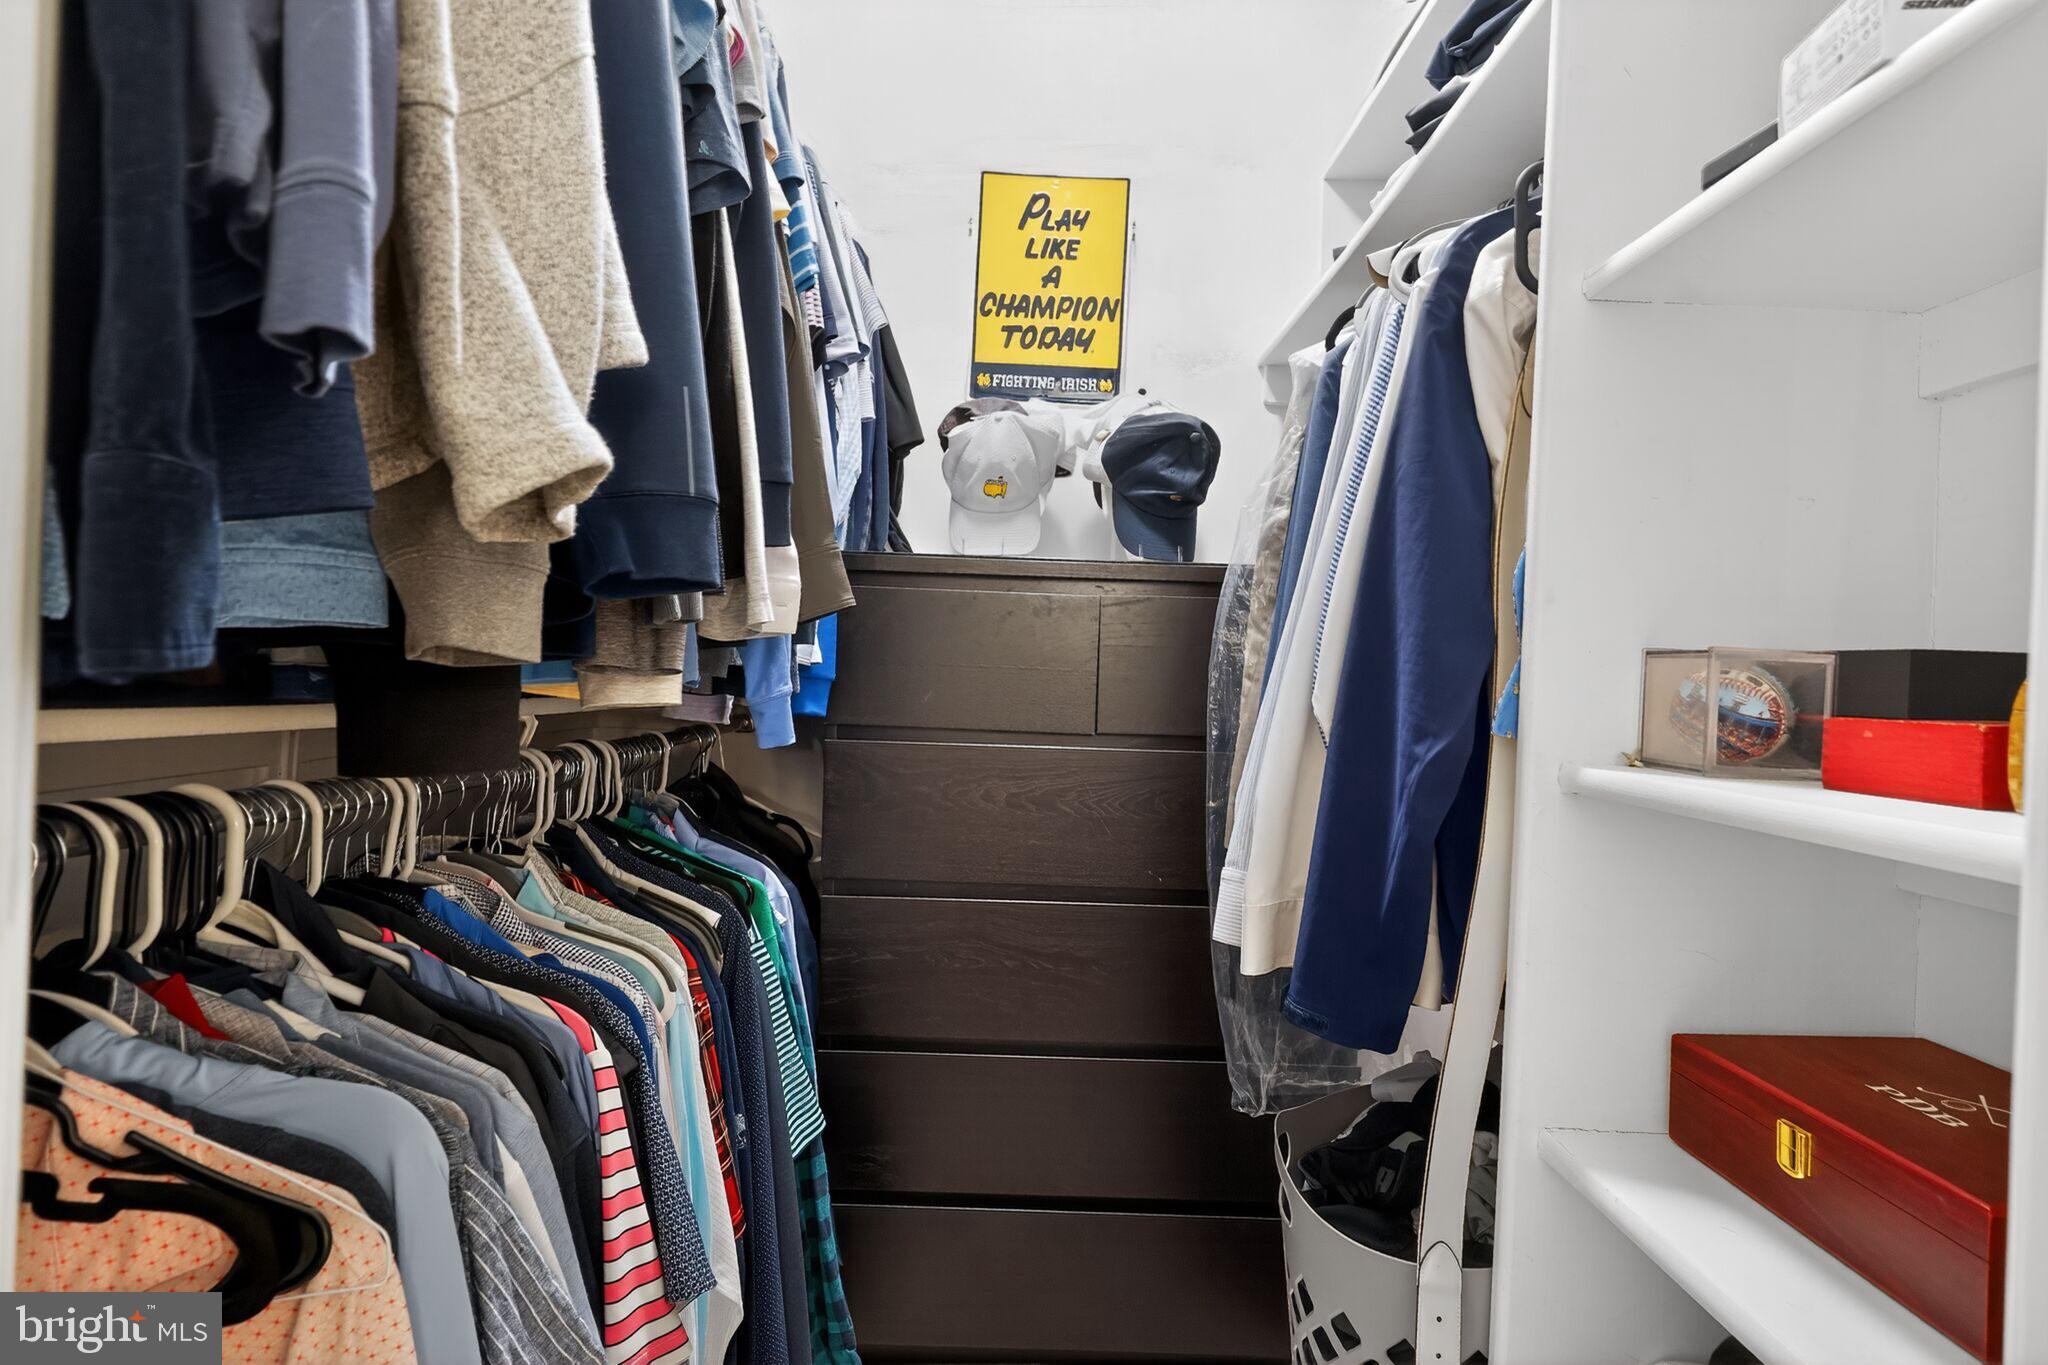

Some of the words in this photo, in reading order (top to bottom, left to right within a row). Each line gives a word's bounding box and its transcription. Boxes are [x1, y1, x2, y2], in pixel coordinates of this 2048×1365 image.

[1018, 193, 1090, 232] PLAY
[1025, 237, 1081, 260] LIKE
[1041, 265, 1062, 289] A
[979, 292, 1121, 322] CHAMPION
[992, 374, 1055, 389] FIGHTING
[1061, 377, 1097, 392] IRISH
